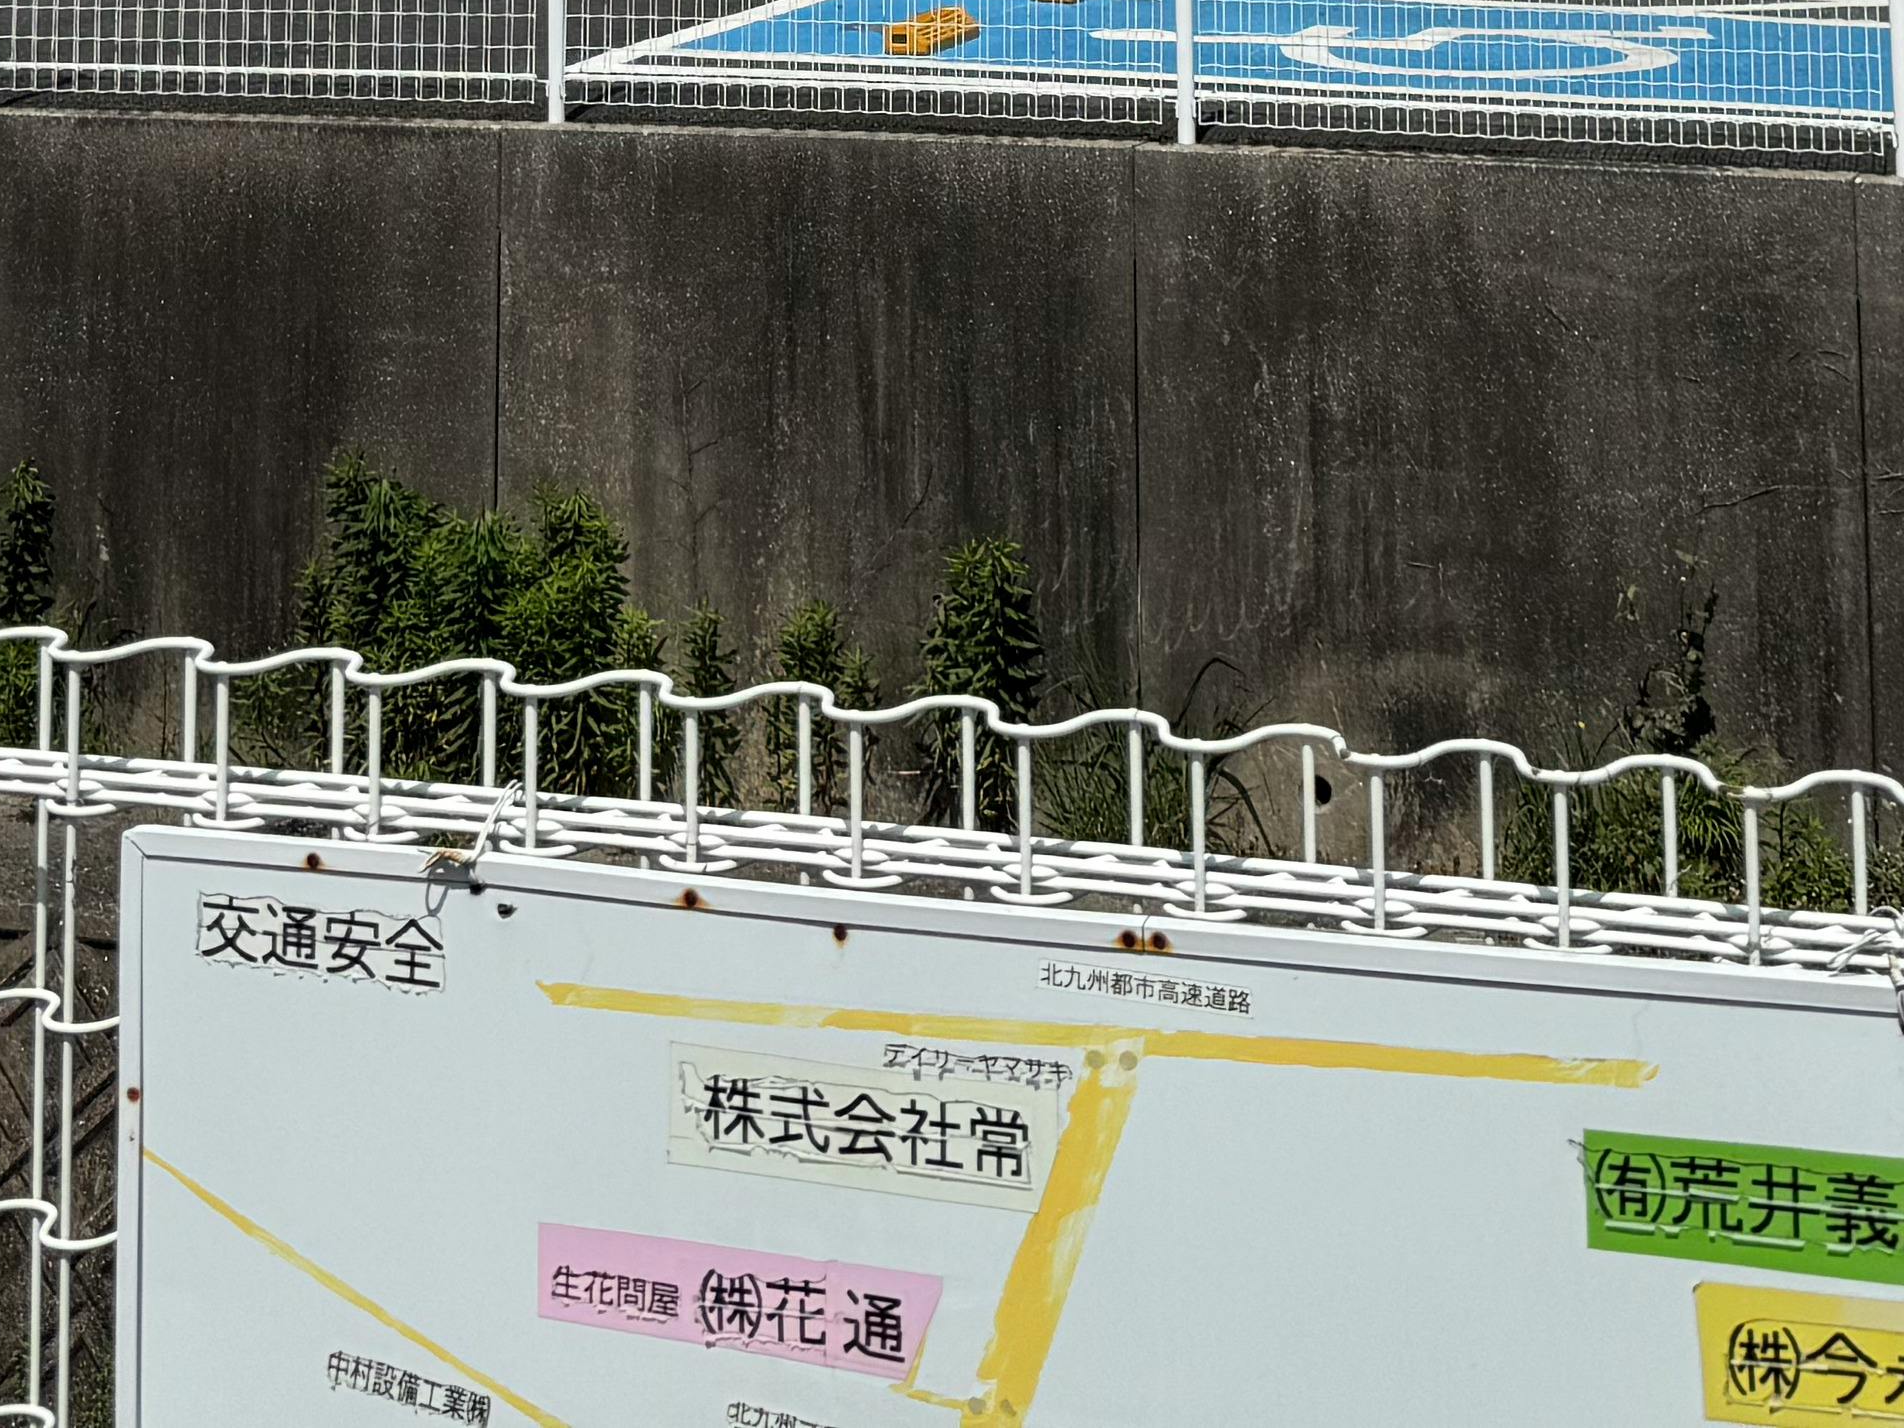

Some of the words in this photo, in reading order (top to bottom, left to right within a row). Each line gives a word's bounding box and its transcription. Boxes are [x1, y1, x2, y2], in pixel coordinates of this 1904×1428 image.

[201, 896, 445, 989] 交通安全
[1040, 962, 1251, 1014] 北九州都市高速道路
[703, 1074, 1029, 1178] 株式会社常
[551, 1265, 680, 1319] 生花問屋
